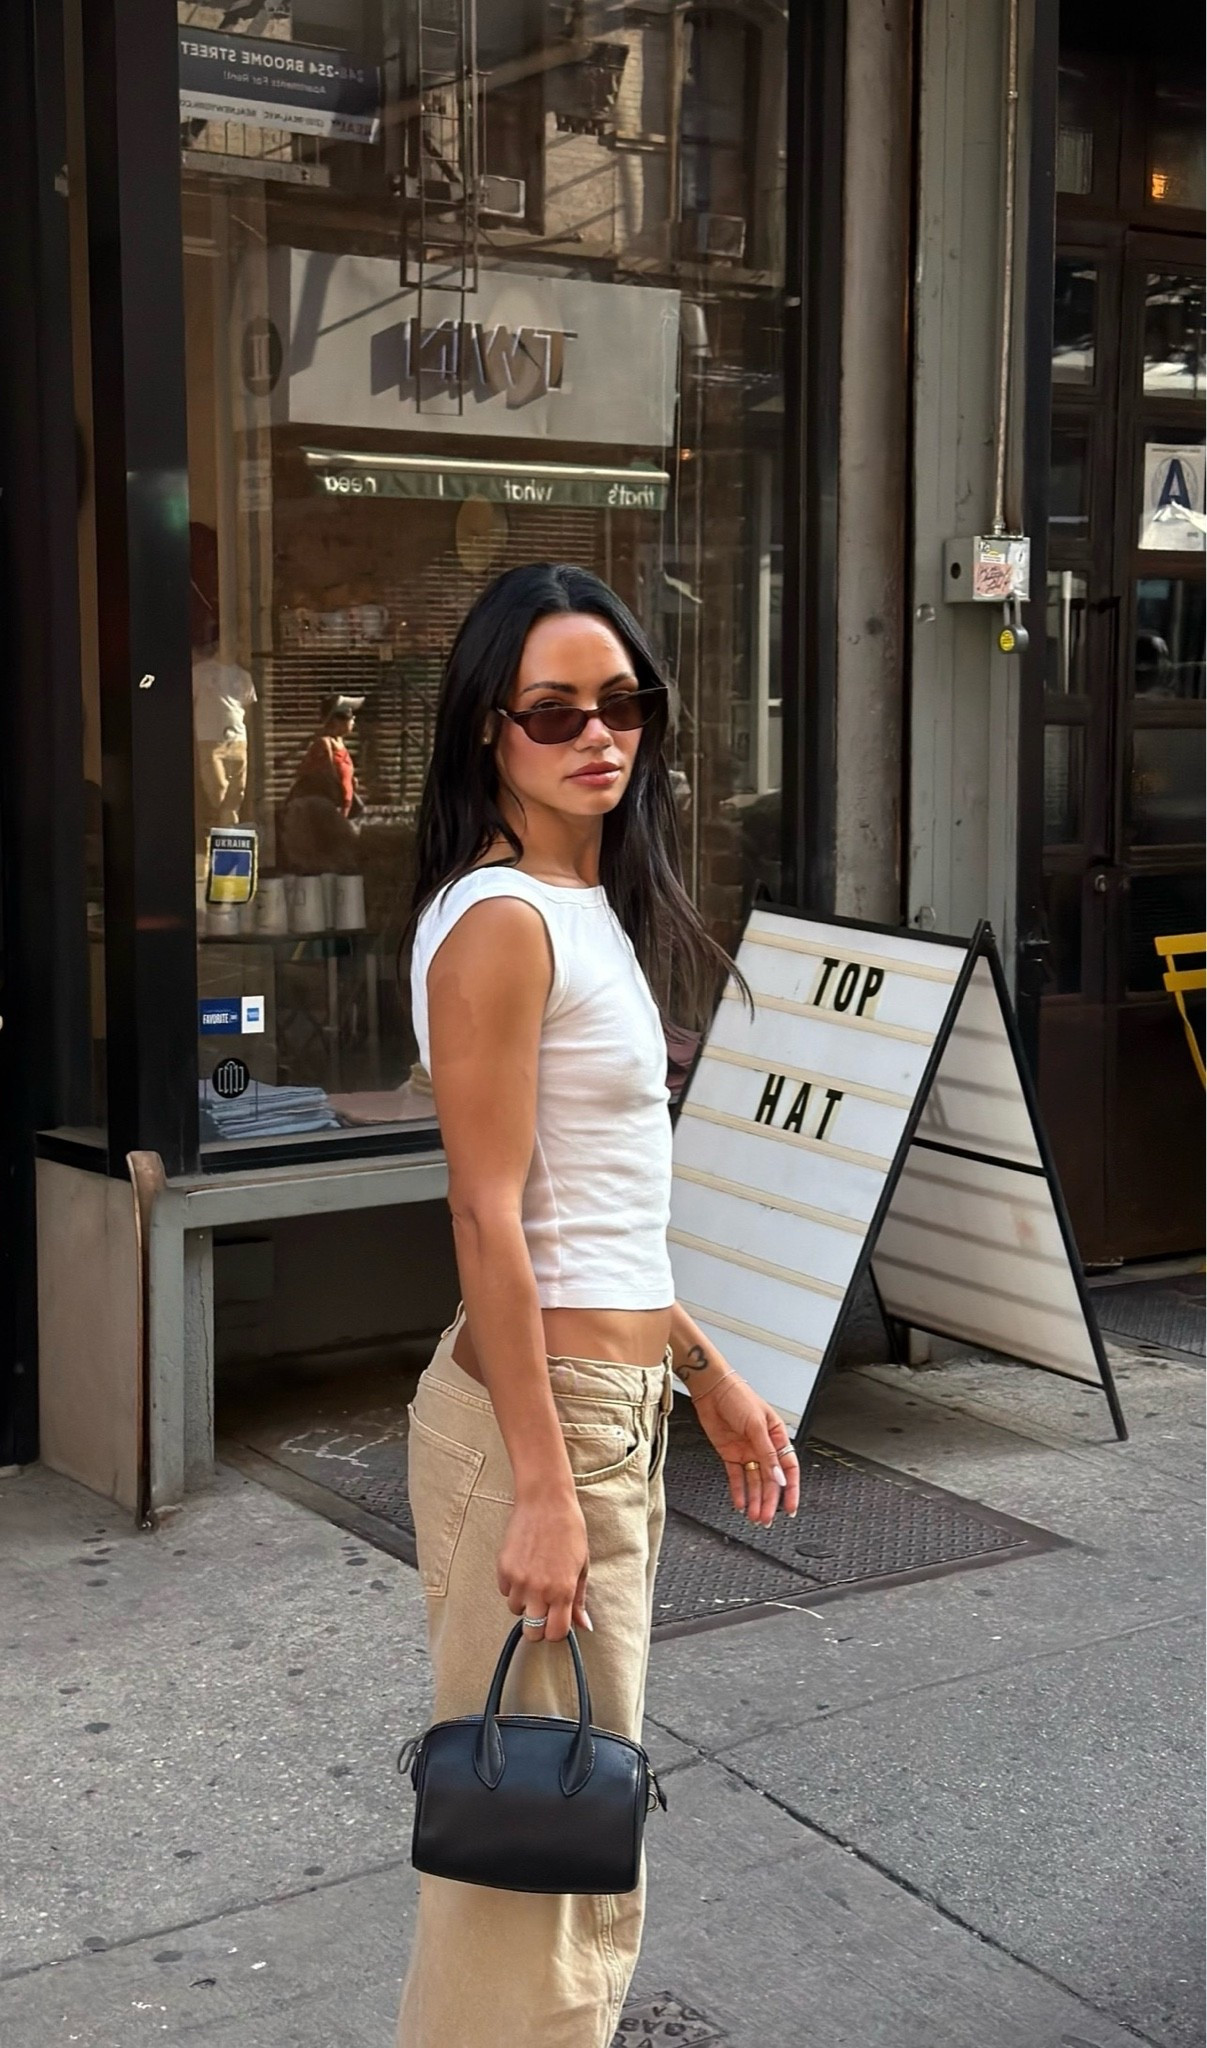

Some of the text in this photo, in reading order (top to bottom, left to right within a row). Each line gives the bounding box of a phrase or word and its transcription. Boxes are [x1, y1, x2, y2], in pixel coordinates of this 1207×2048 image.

[1156, 459, 1192, 512] A
[214, 839, 251, 849] UKRAINE
[813, 957, 885, 1016] TOP
[203, 1013, 229, 1025] FAVORITE
[755, 1073, 844, 1139] HAT
